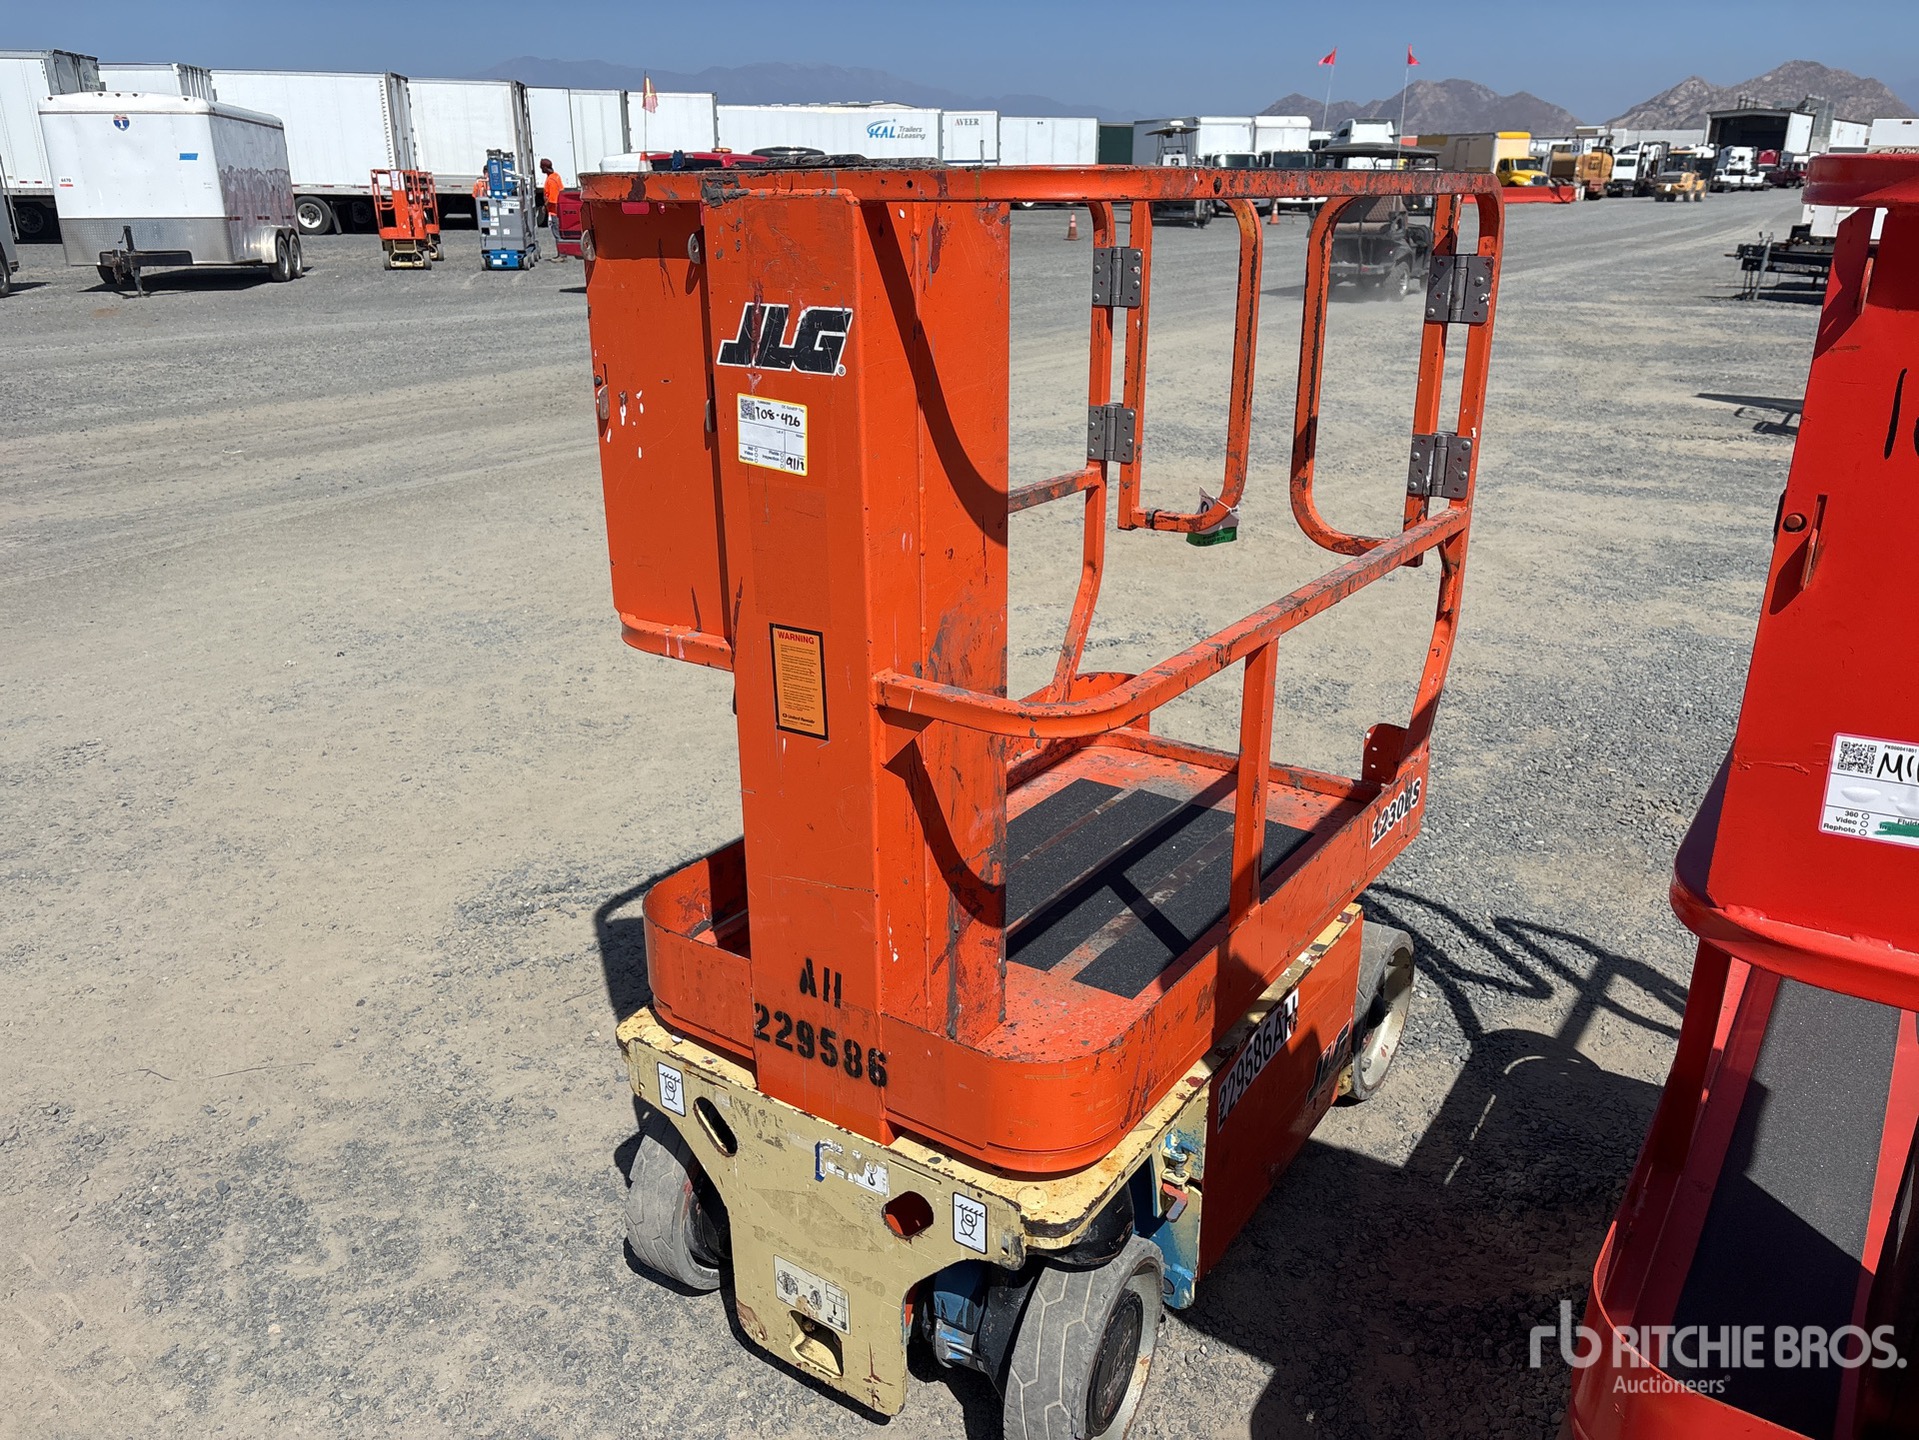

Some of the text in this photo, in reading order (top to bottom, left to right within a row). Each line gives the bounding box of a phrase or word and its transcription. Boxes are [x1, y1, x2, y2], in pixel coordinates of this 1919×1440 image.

[867, 123, 896, 138] KAL
[716, 302, 853, 376] JLG
[777, 630, 815, 645] WARNING
[1835, 815, 1858, 825] Video
[1845, 810, 1859, 818] 360
[1823, 822, 1856, 833] Rephoto
[754, 1002, 888, 1088] 229586
